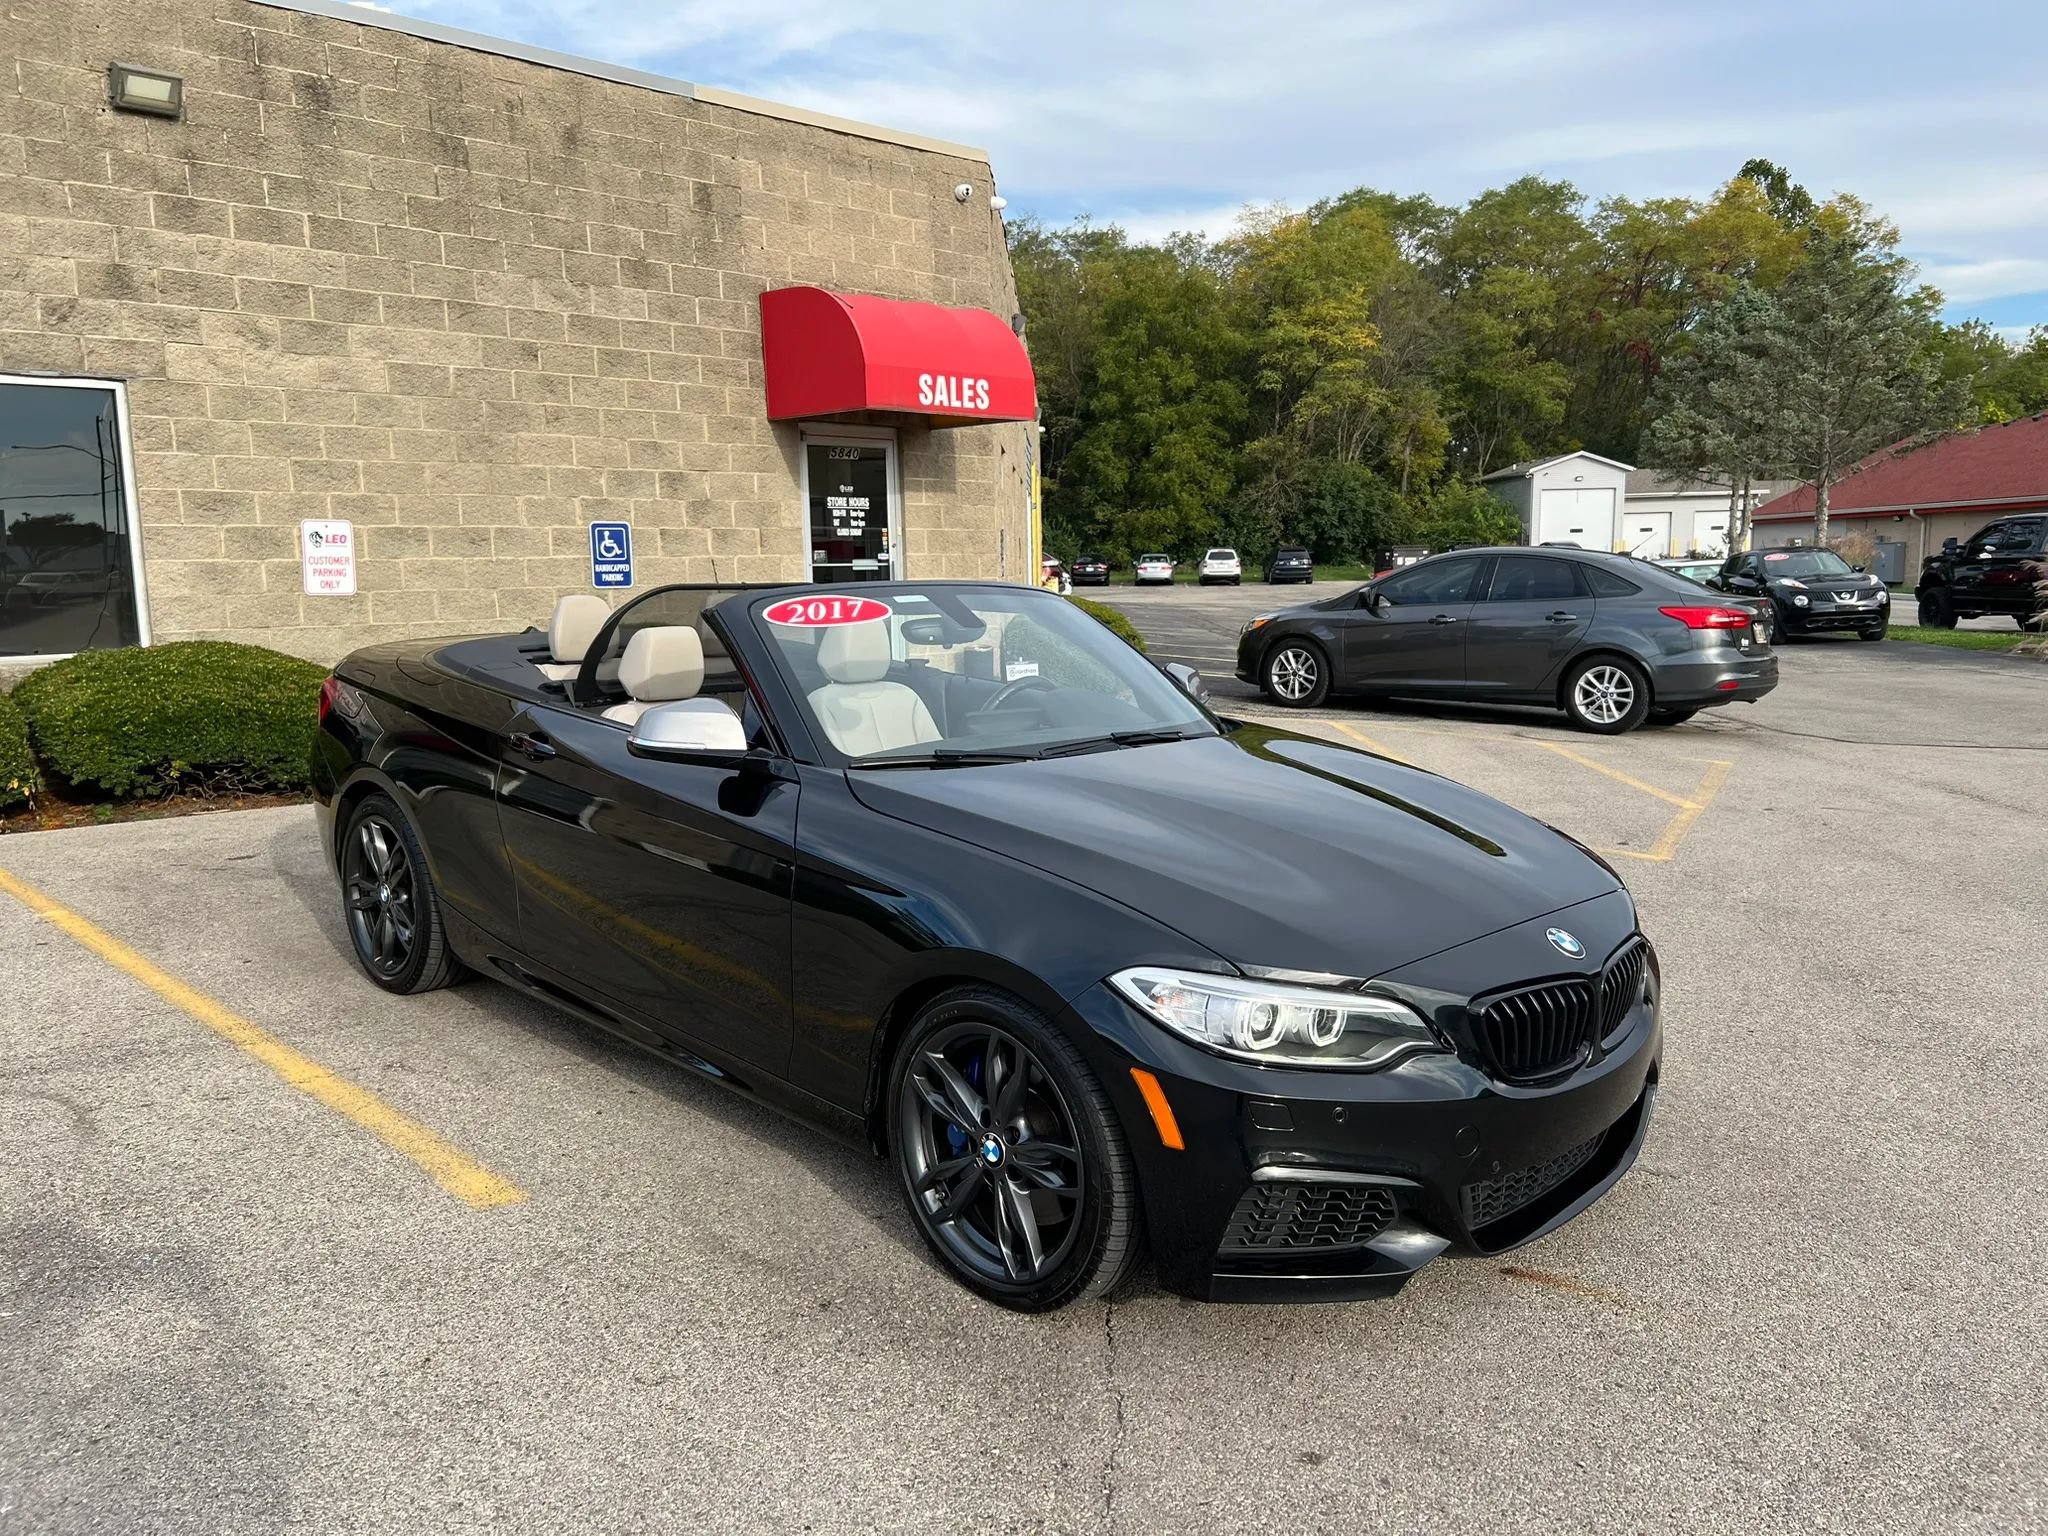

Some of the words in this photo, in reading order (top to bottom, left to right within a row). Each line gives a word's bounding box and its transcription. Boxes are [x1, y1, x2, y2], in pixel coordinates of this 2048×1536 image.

[918, 373, 990, 410] SALES
[830, 448, 859, 459] 5840
[827, 496, 848, 507] STORE
[848, 497, 870, 507] HOURS
[325, 534, 347, 544] LEO
[308, 556, 350, 566] CUSTOMER
[312, 568, 347, 577] PARKING
[595, 563, 630, 573] HANDICAPPED
[601, 573, 624, 582] PARKING
[320, 580, 341, 590] ONLY
[786, 600, 864, 624] 2017
